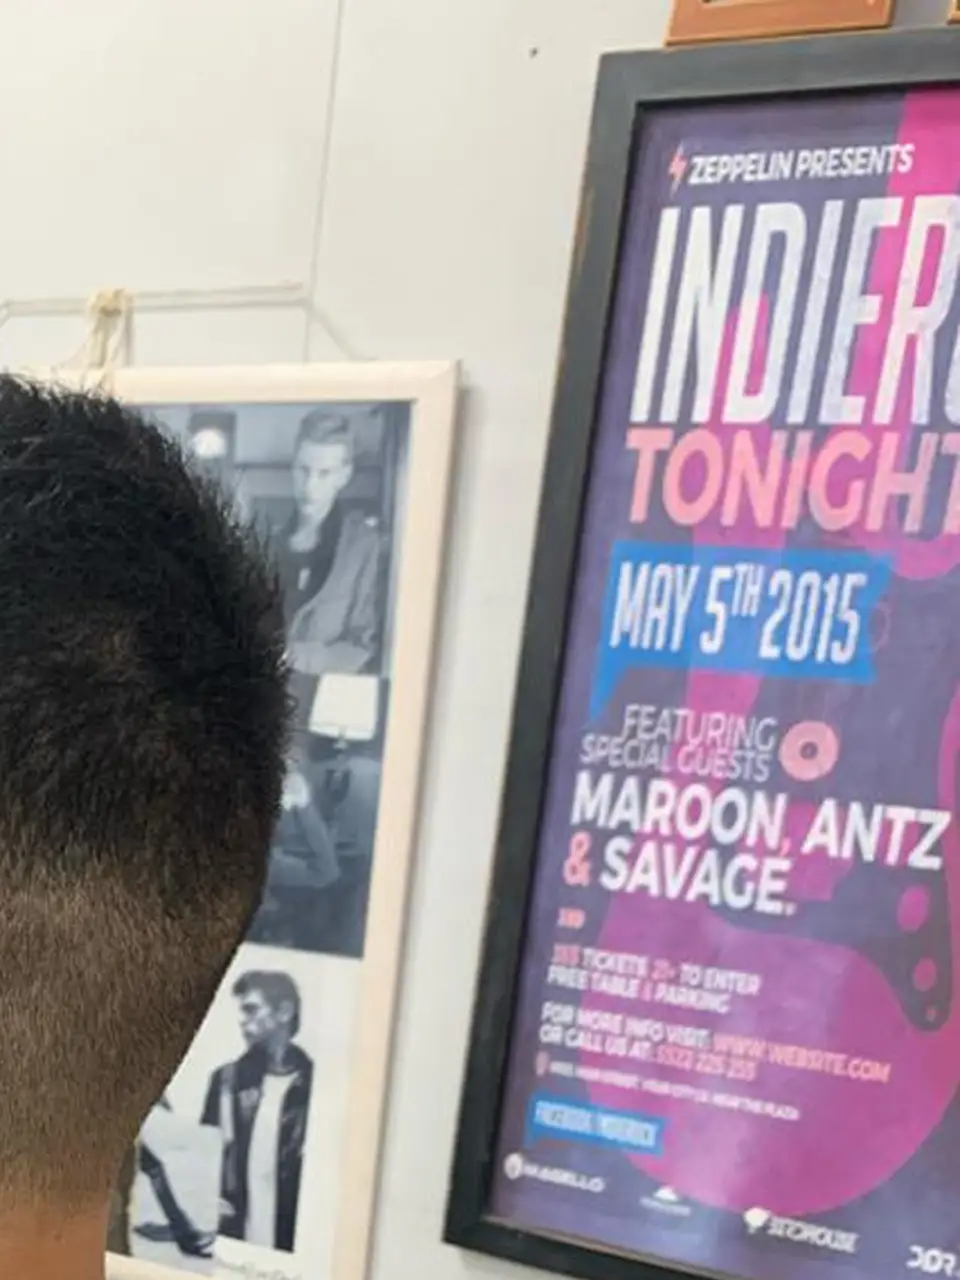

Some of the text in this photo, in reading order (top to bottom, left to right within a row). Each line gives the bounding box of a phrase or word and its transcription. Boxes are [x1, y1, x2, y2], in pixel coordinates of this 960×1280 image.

[688, 144, 915, 185] ZEPPELIN PRESENTS
[630, 194, 960, 426] INDIER
[609, 560, 700, 652] MAY
[758, 568, 868, 665] 2015
[621, 703, 778, 752] FEATURING
[580, 734, 774, 784] SPECIAL GUESTS
[570, 770, 952, 872] MAROON, ANTZ
[563, 831, 592, 887] &
[547, 965, 589, 990] FREE
[591, 971, 640, 999] TABLE
[654, 982, 731, 1014] PARKING
[704, 967, 763, 996] ENTER
[539, 1024, 563, 1045] OR
[564, 1027, 604, 1053] CALL
[542, 1001, 575, 1024] FOR
[577, 1008, 623, 1034] MORE
[624, 1016, 665, 1041] INFO
